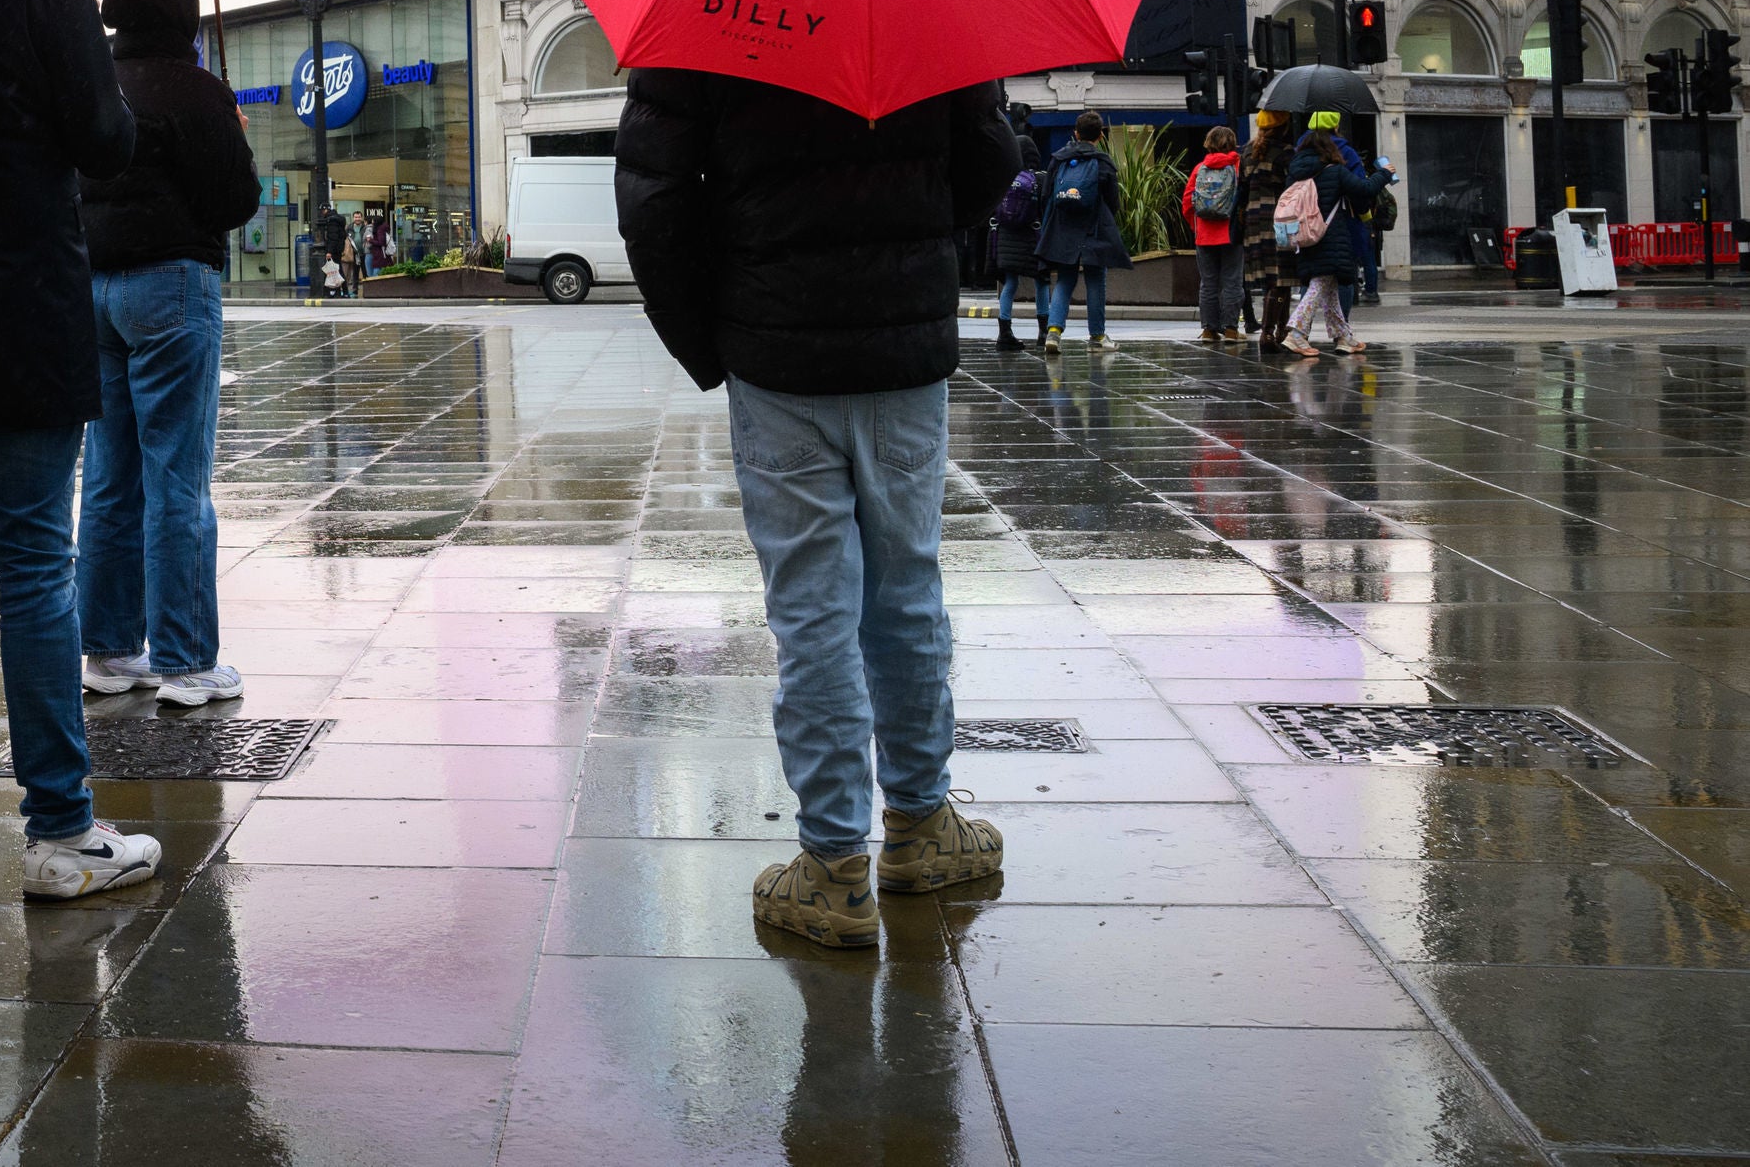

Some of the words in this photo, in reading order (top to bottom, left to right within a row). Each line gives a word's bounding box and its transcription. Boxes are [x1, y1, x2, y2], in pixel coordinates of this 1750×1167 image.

[721, 29, 793, 50] PICCADILLY
[383, 59, 434, 86] beauty
[234, 84, 280, 105] armacy
[366, 207, 384, 217] DIOR
